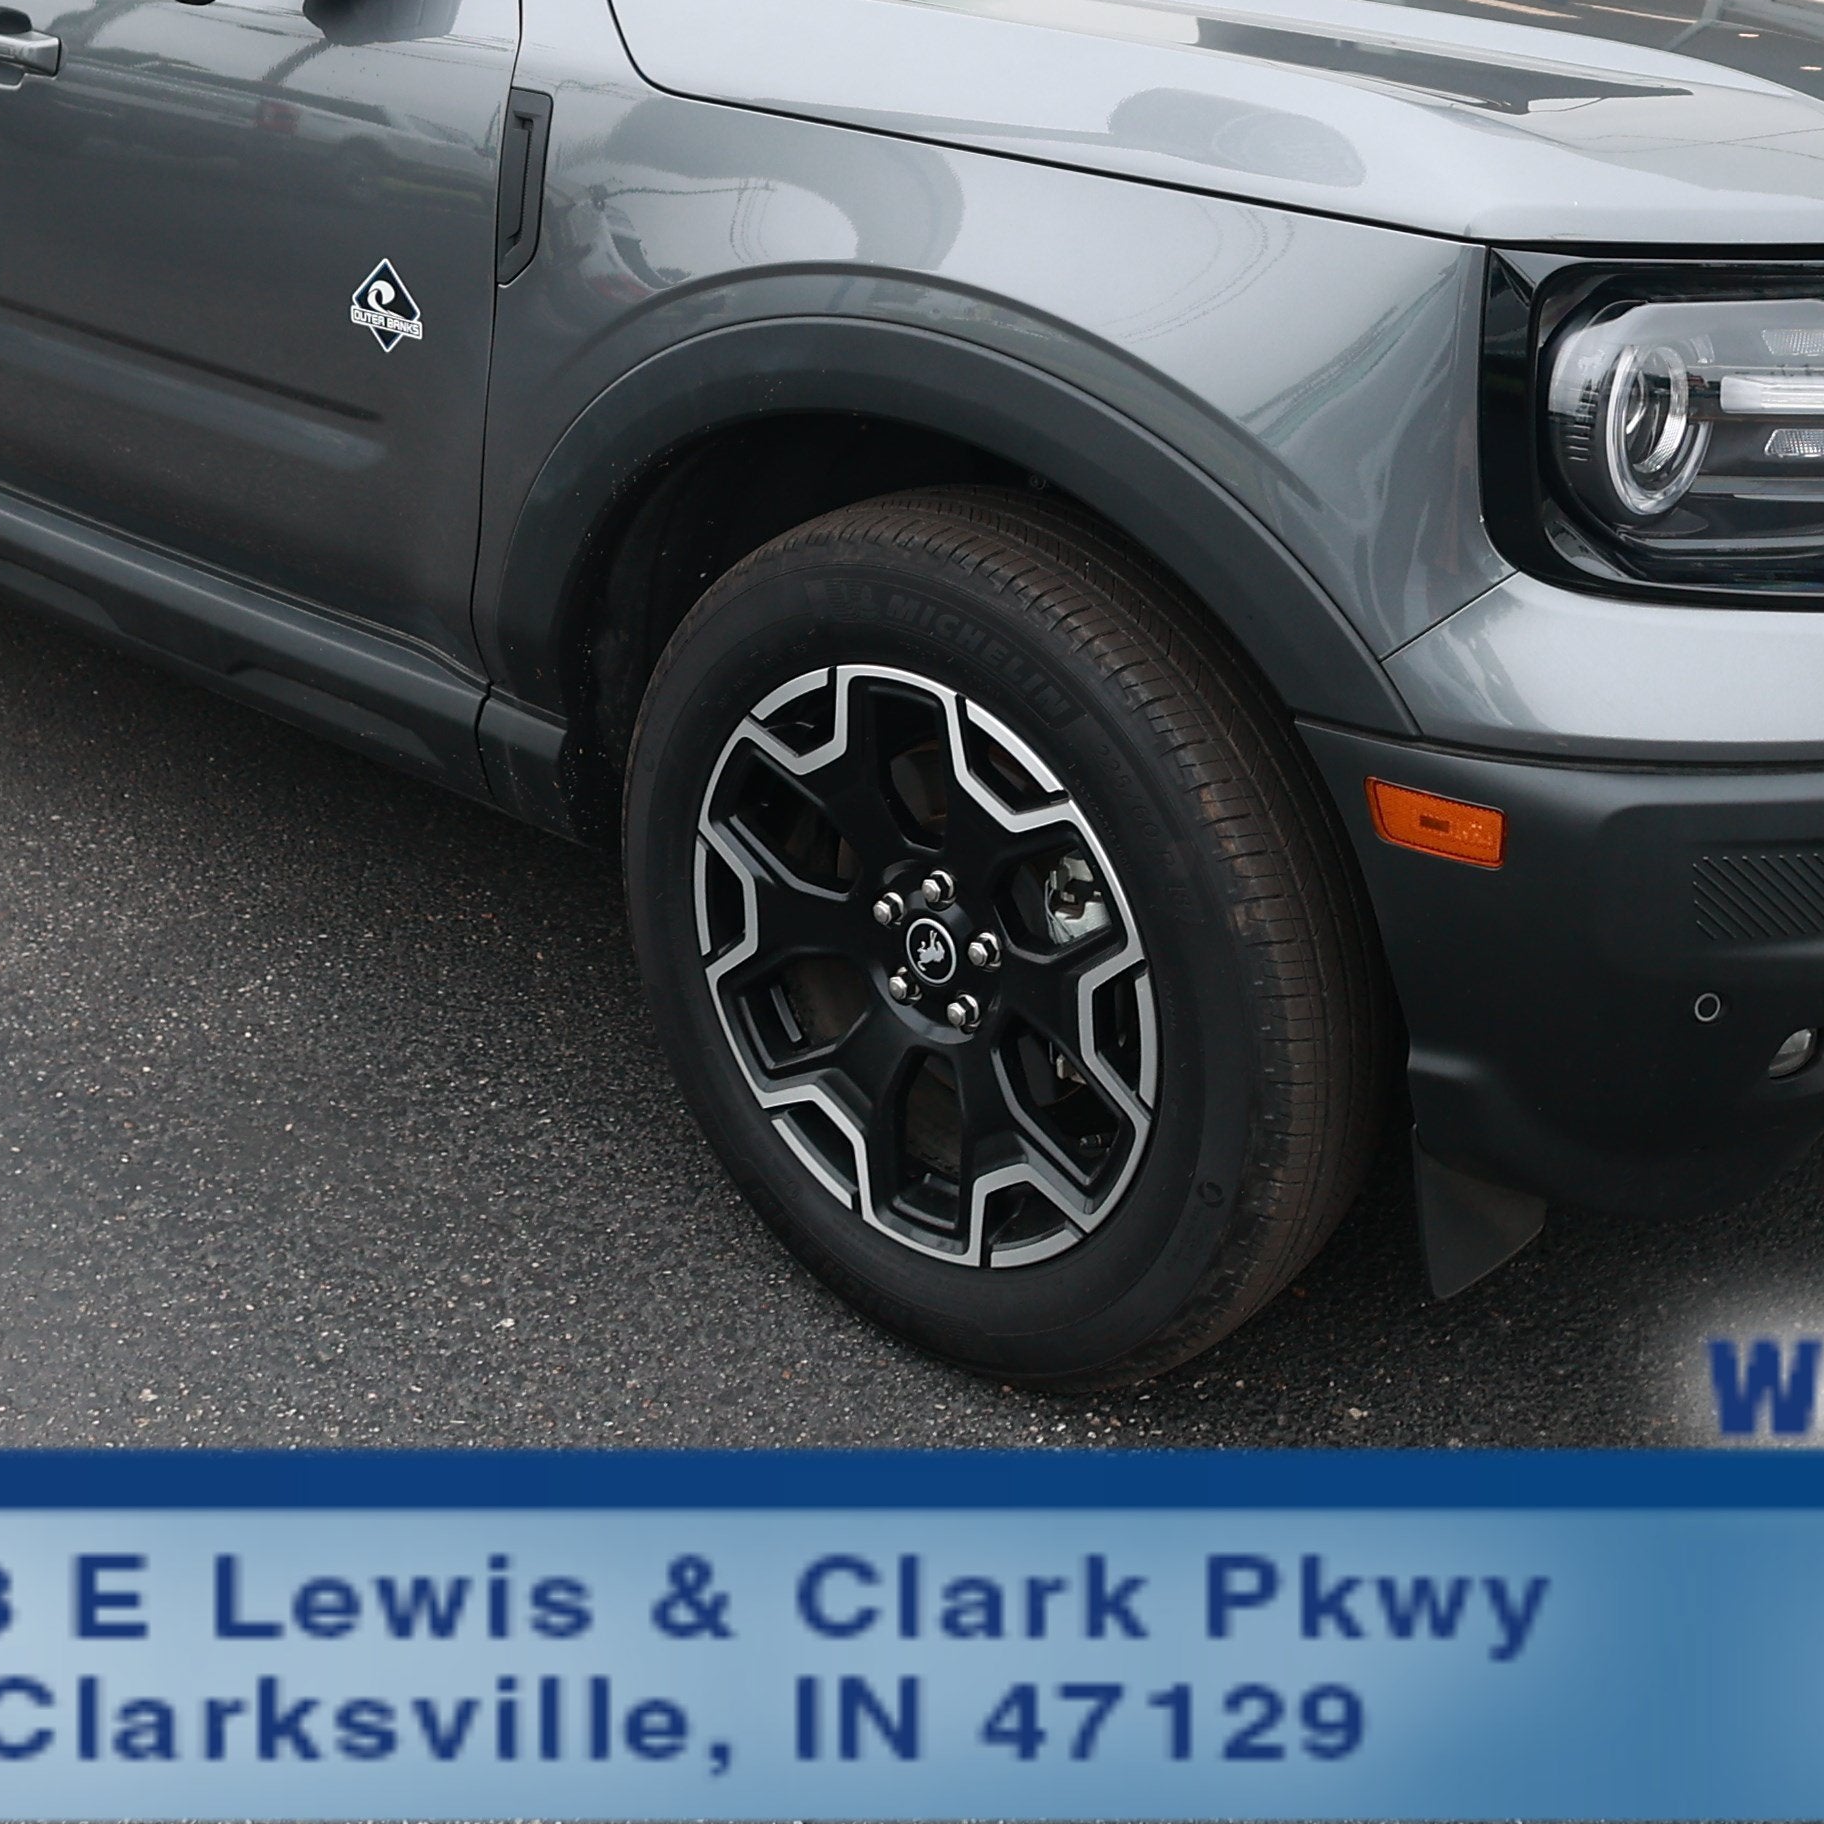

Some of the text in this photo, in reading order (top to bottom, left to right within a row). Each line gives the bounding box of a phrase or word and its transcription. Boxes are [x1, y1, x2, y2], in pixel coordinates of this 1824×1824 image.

[354, 309, 420, 335] OUTER BANKS
[884, 592, 1071, 727] MICHELIN
